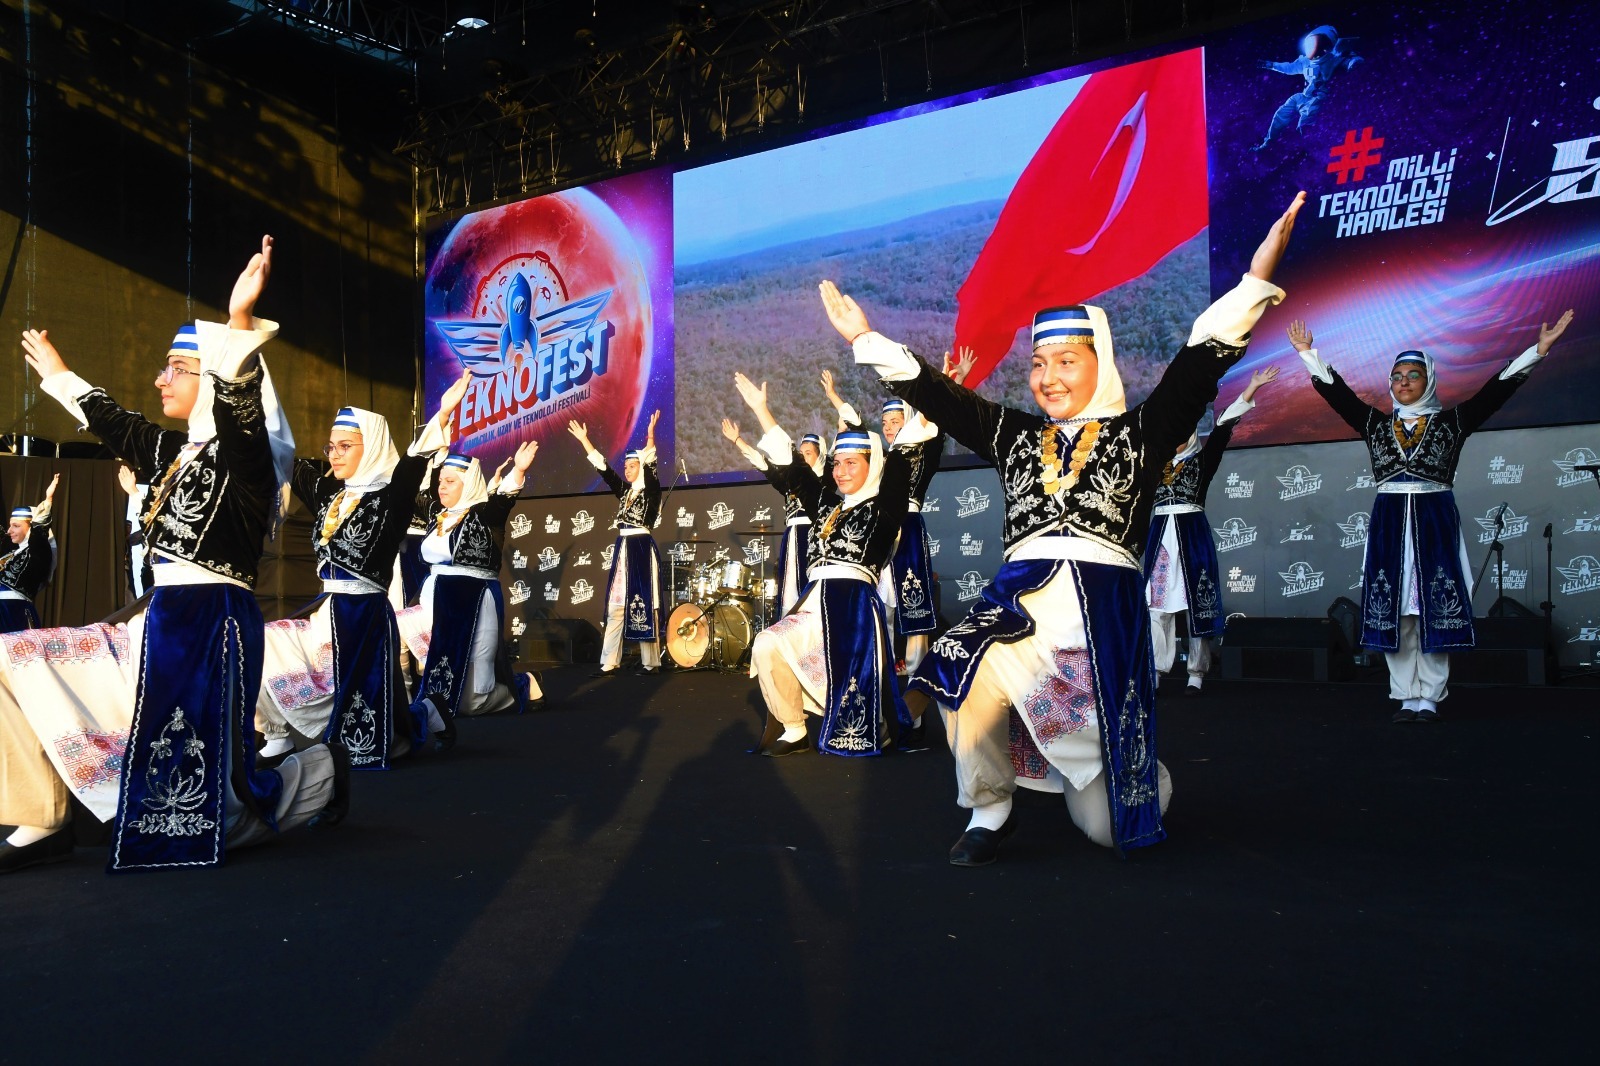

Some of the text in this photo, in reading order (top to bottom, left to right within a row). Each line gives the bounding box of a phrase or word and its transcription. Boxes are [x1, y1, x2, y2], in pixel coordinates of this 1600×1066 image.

[452, 320, 613, 442] EKNOFEST
[497, 421, 514, 438] UZAY
[514, 416, 522, 430] VE
[523, 400, 558, 427] TEKNOLOJİ
[558, 385, 591, 412] FESTİVALİ
